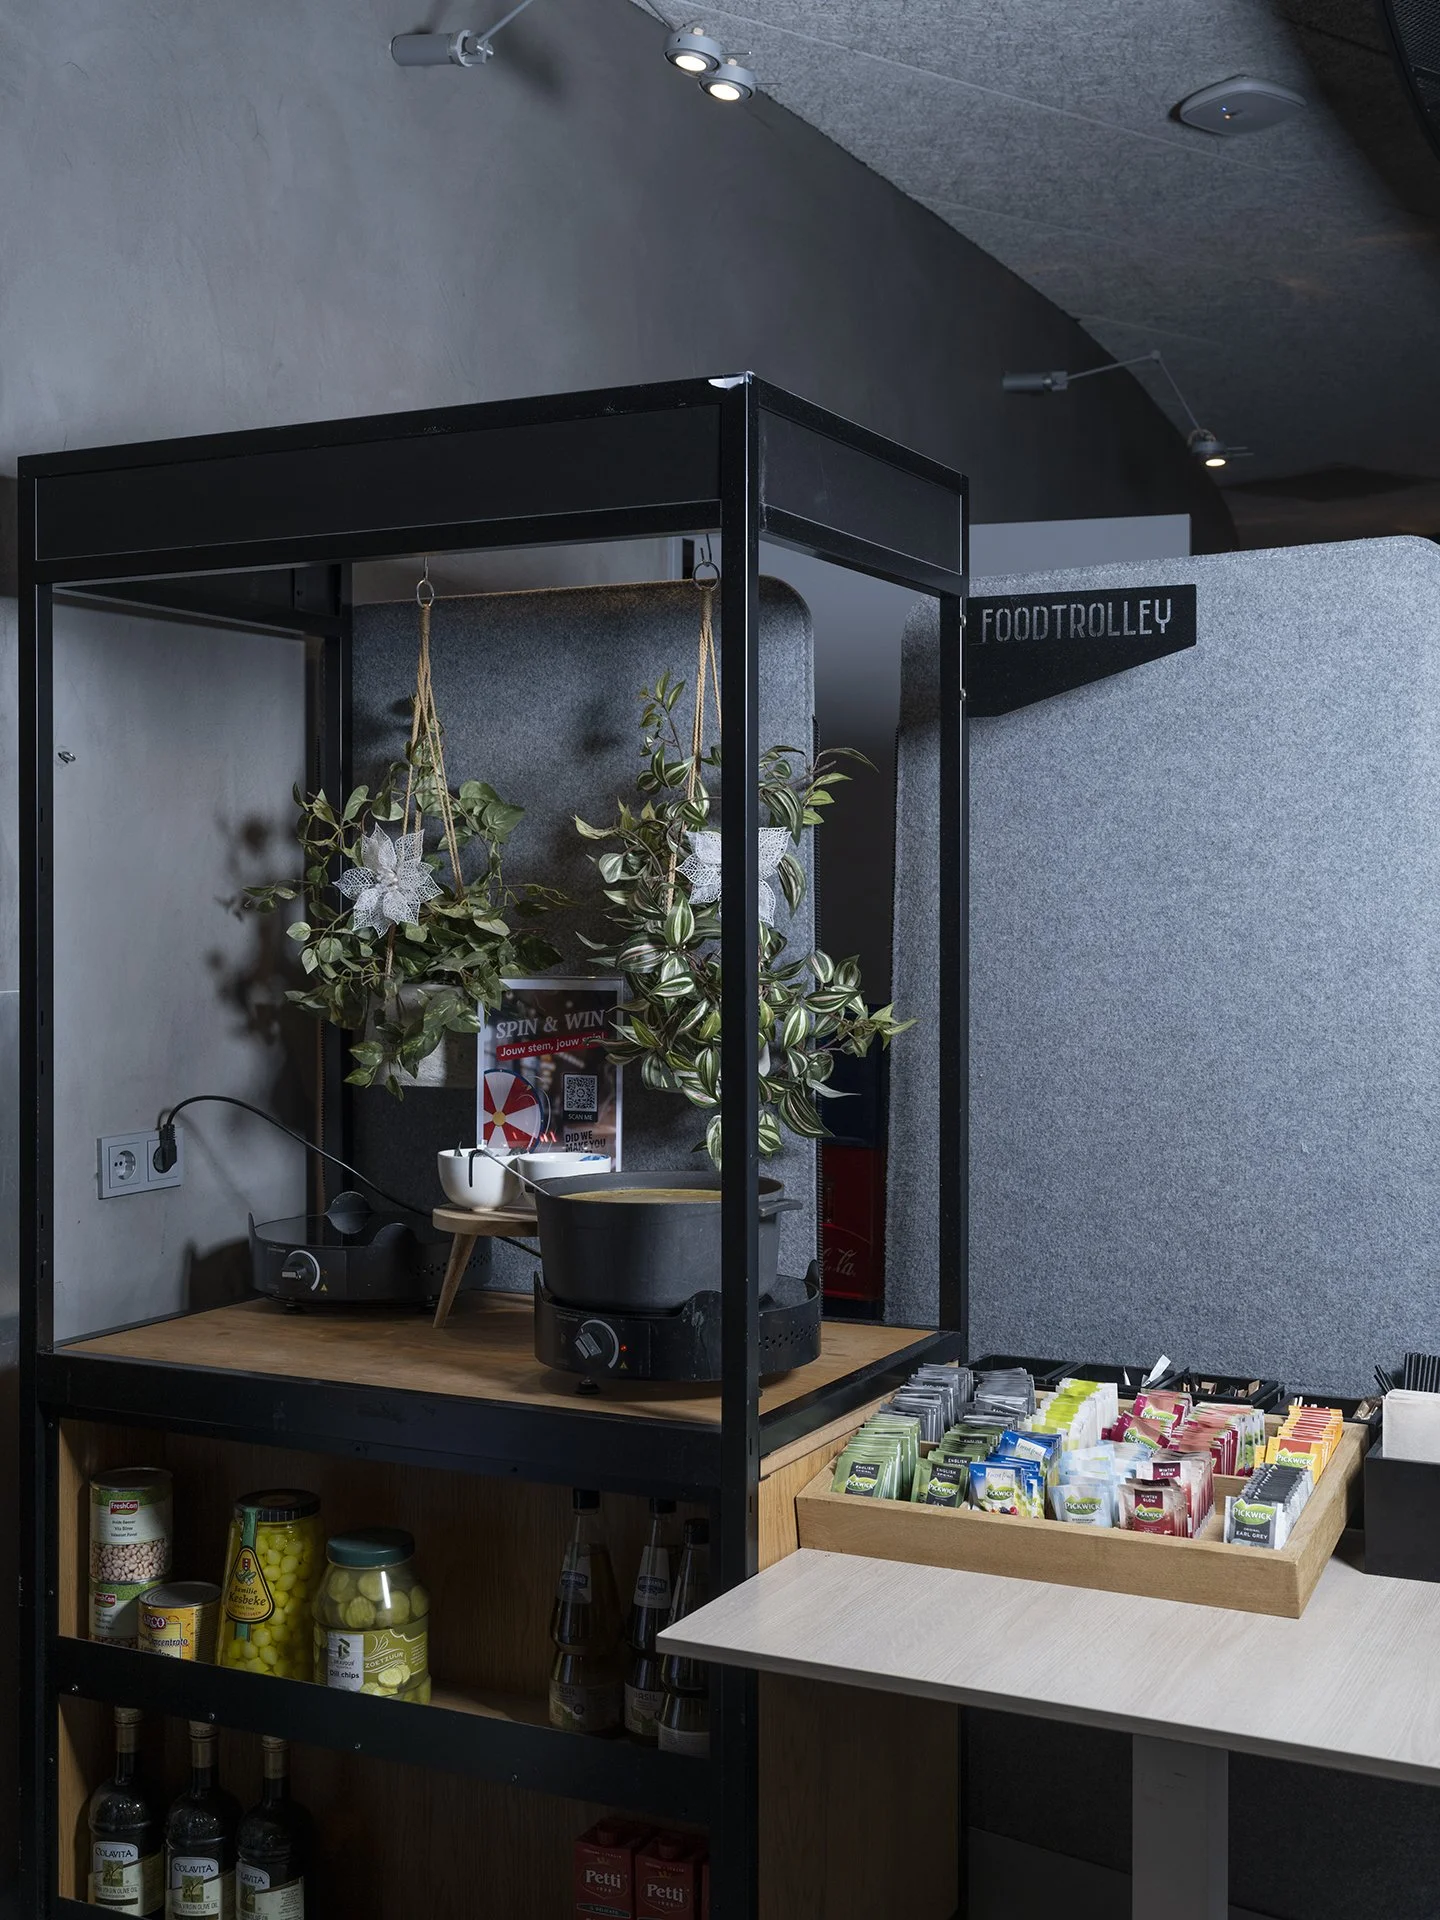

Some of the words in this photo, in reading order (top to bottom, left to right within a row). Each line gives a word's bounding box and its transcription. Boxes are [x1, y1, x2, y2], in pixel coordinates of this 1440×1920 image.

[981, 598, 1172, 644] FOODTROLLEY
[496, 1018, 539, 1039] SPIN
[543, 1016, 558, 1033] &
[564, 1009, 605, 1031] WIN
[501, 1047, 526, 1057] Jouw
[528, 1042, 554, 1053] stem,
[556, 1038, 580, 1051] jouw
[565, 1132, 579, 1143] DID
[580, 1130, 593, 1140] WE
[565, 1141, 588, 1153] MAKE
[589, 1138, 606, 1149] YOU
[1275, 1454, 1313, 1466] PICKWICK
[1064, 1501, 1101, 1511] PICKWICK
[1232, 1507, 1272, 1521] PICKWICK
[228, 1591, 267, 1606] Kesbeke
[341, 1671, 359, 1680] chips
[95, 1847, 134, 1858] COLAVITA
[174, 1862, 214, 1873] COLAVITA
[585, 1869, 621, 1889] Petti
[647, 1883, 684, 1904] Petti
